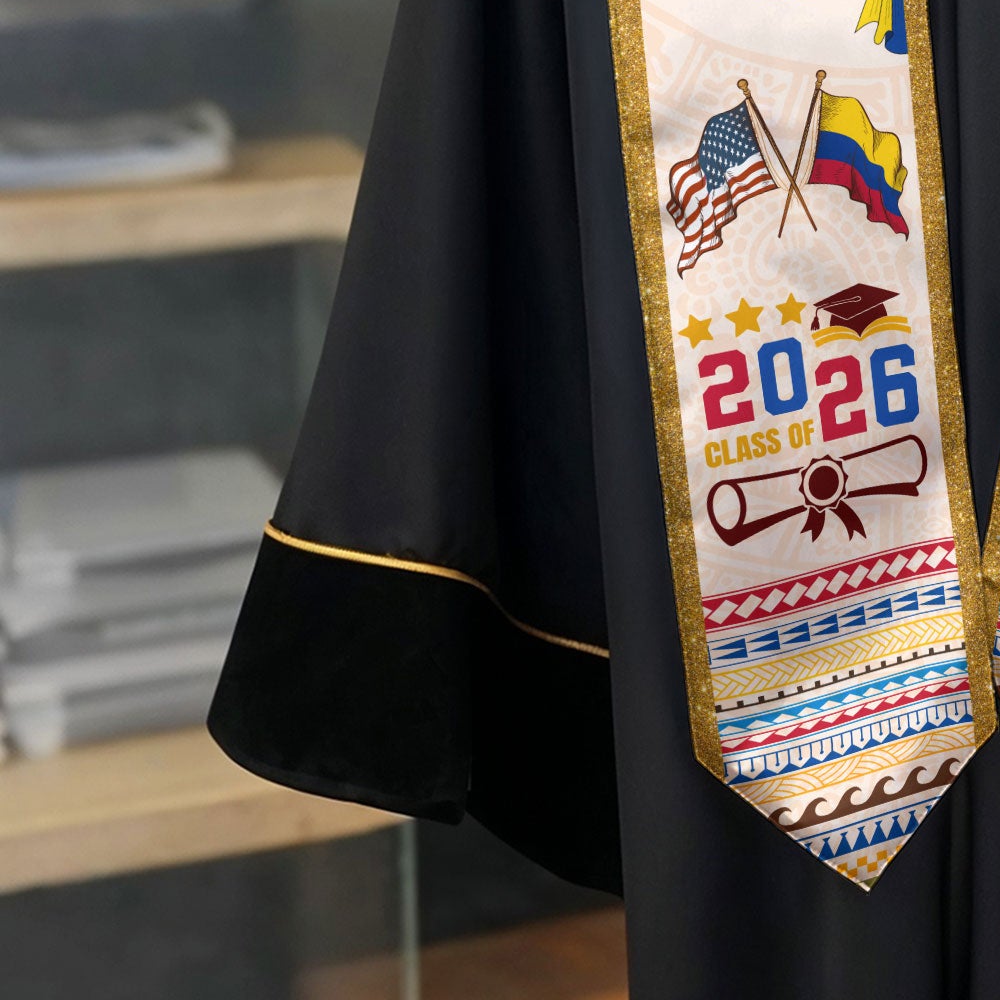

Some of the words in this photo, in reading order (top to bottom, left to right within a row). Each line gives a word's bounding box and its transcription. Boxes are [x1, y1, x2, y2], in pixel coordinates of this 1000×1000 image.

[698, 337, 920, 443] 2026
[704, 428, 782, 468] CLASS
[788, 418, 815, 449] OF
